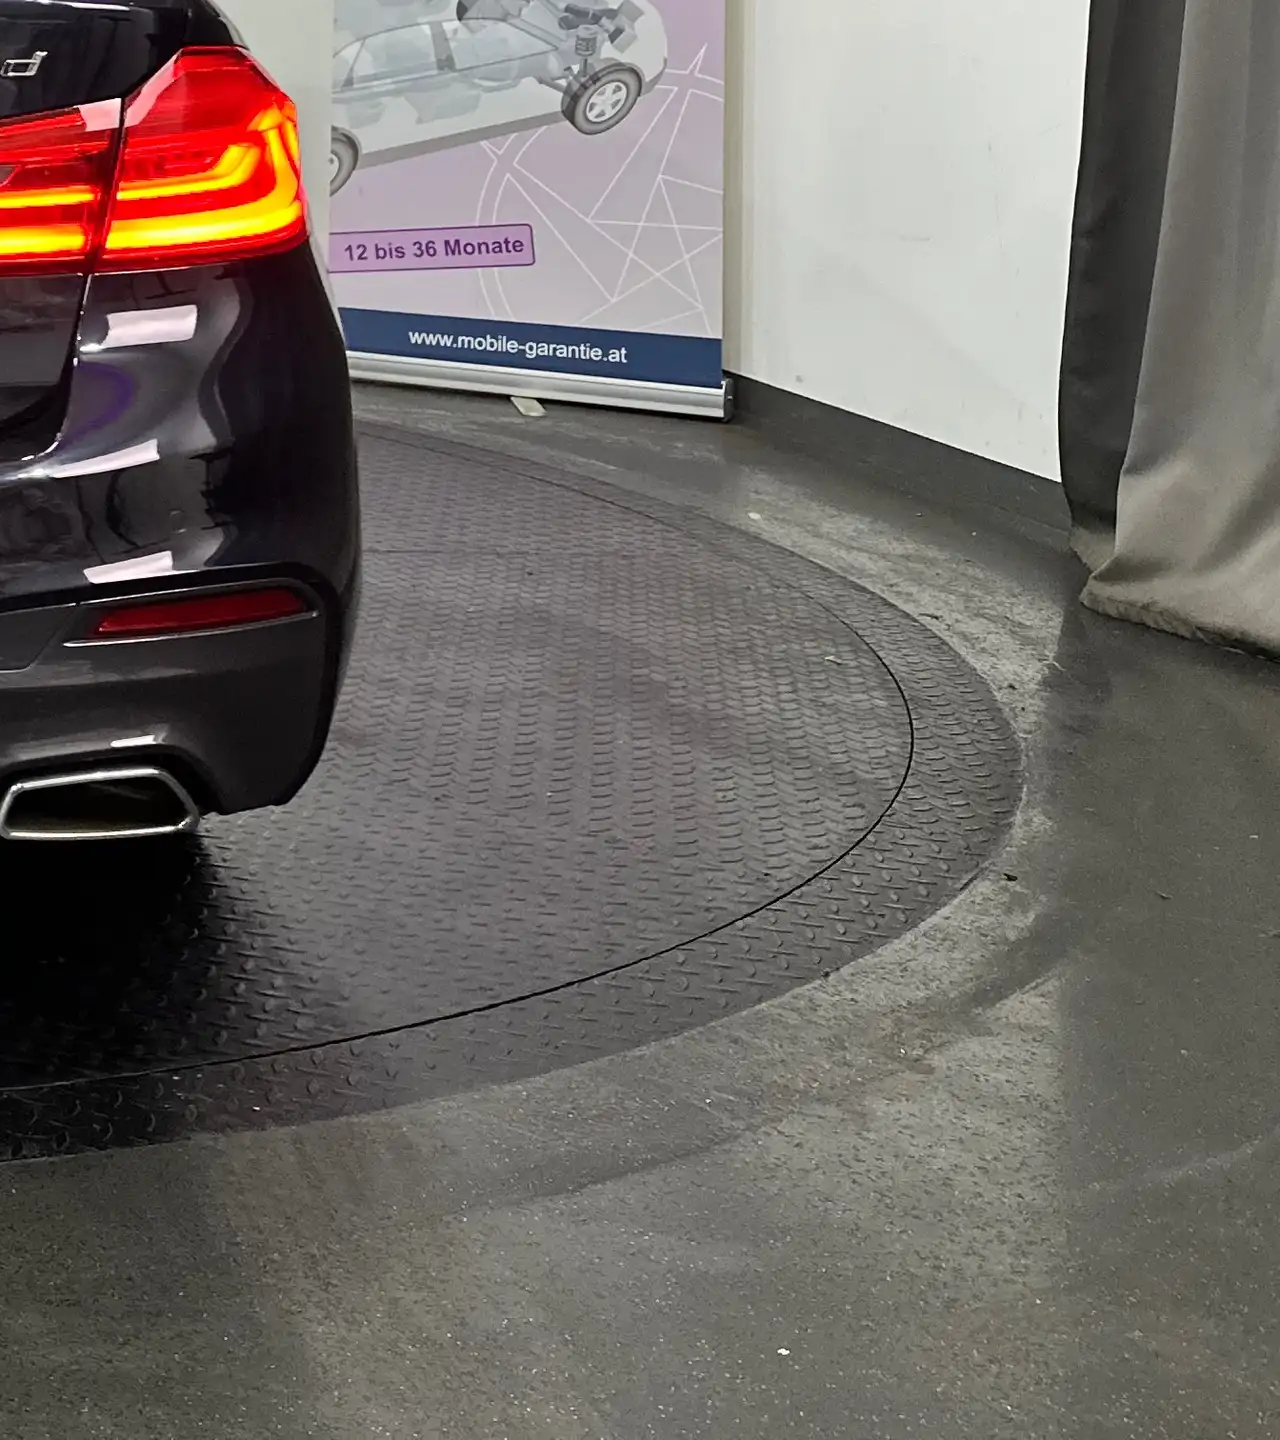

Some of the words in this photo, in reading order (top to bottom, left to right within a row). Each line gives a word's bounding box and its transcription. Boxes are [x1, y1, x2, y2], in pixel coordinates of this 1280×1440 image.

[344, 243, 368, 262] 12
[375, 241, 406, 261] bis
[412, 240, 438, 259] 36
[443, 236, 525, 257] Monate
[408, 329, 628, 364] www.mobile-garantie.at
